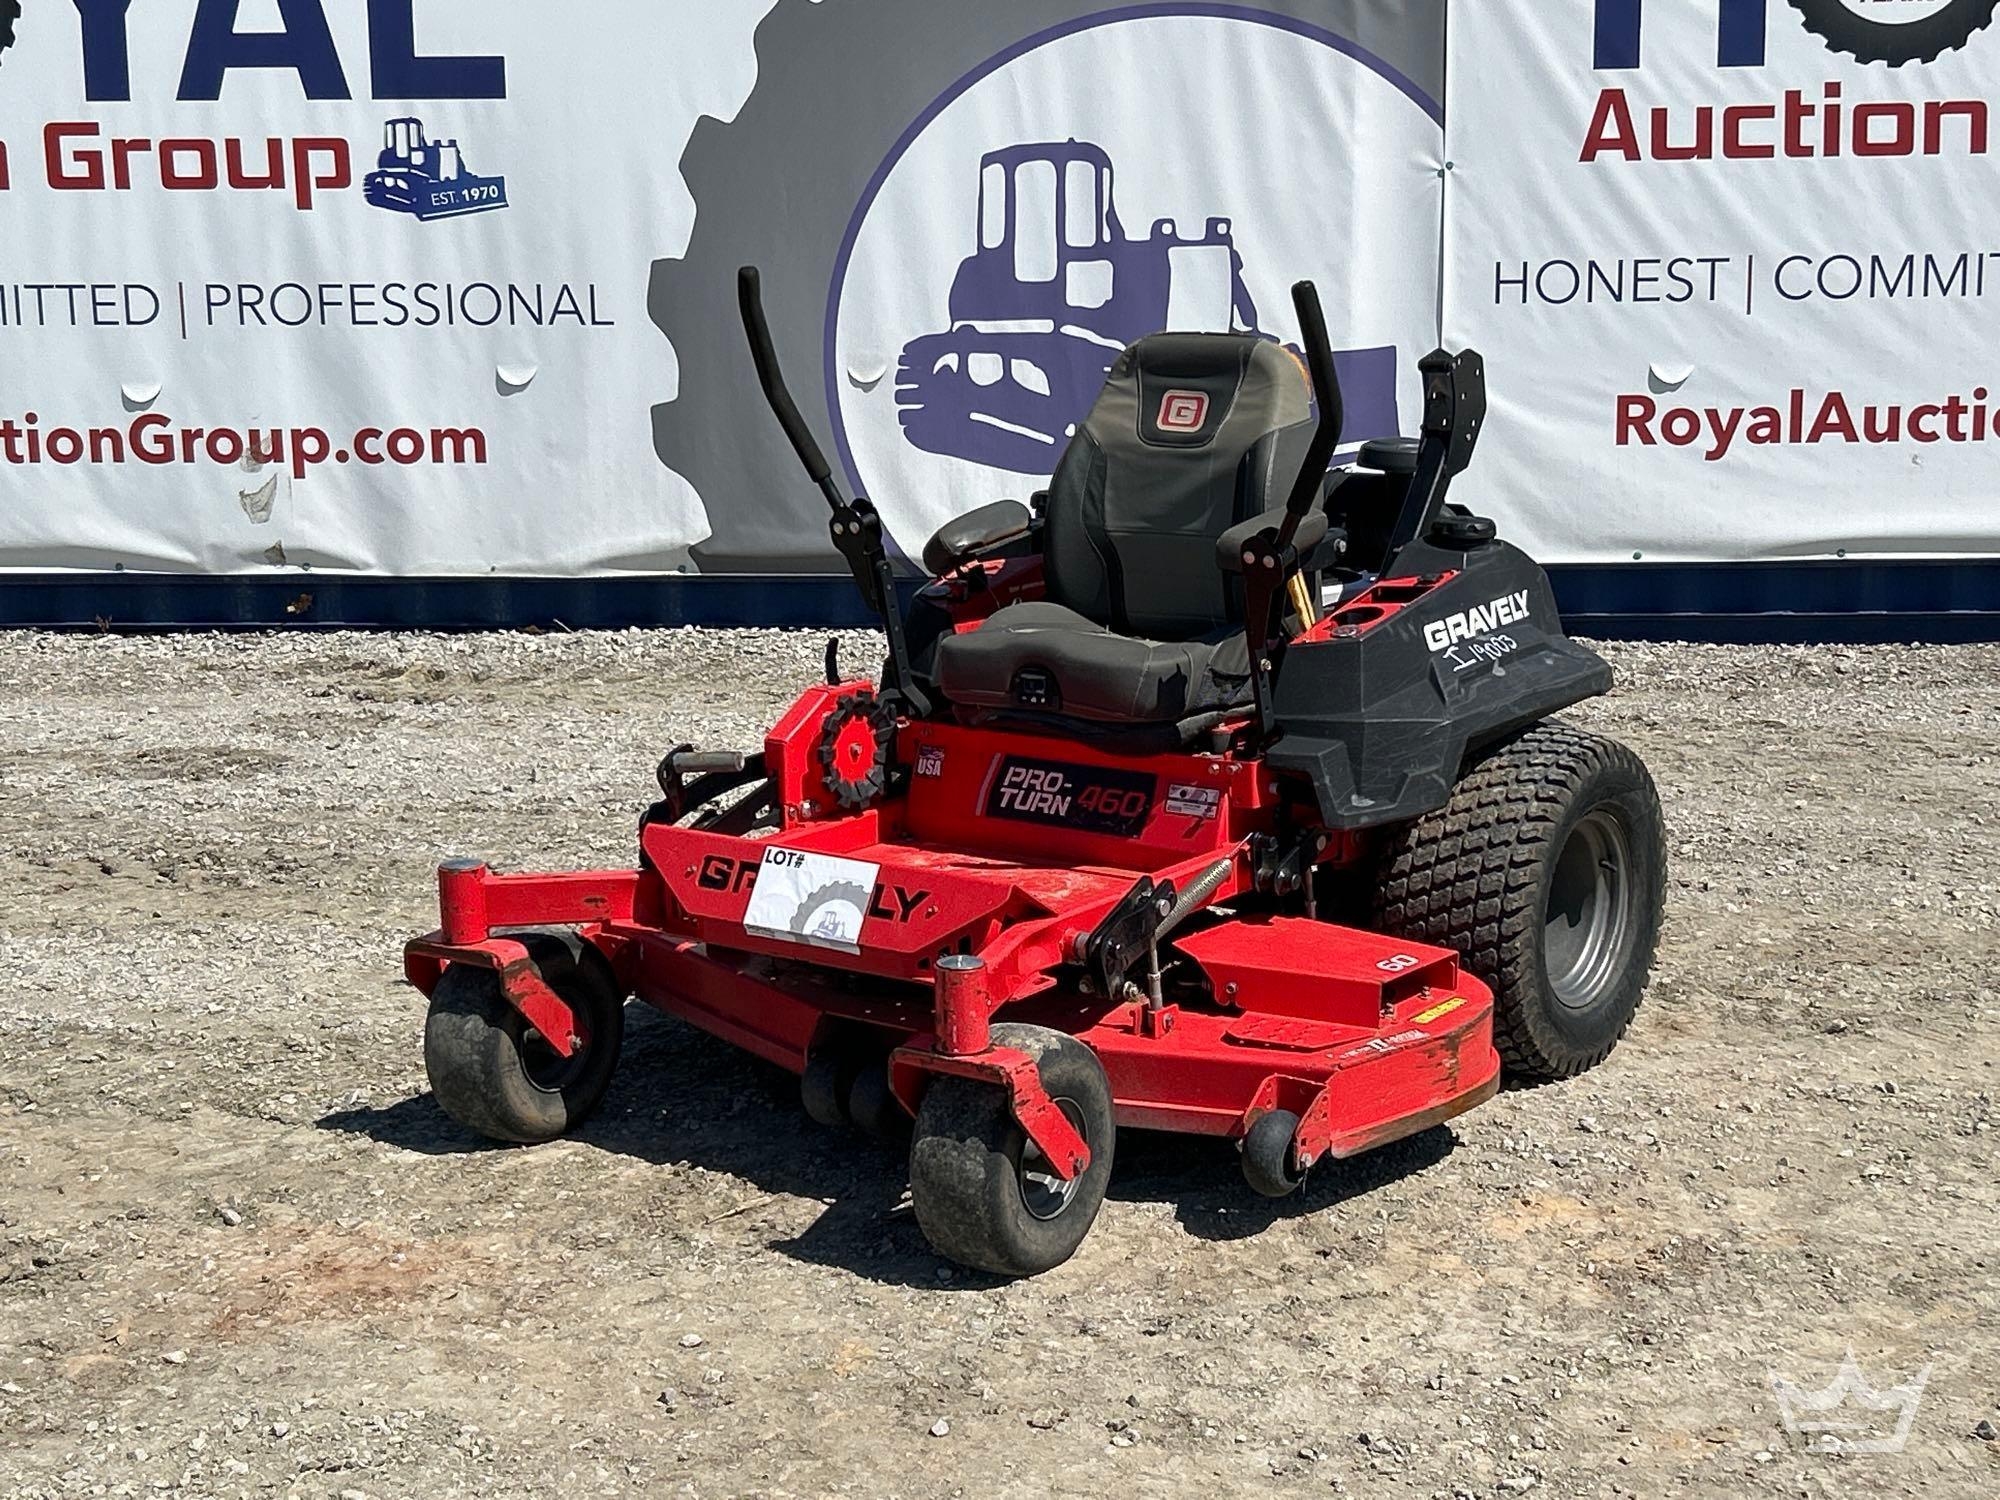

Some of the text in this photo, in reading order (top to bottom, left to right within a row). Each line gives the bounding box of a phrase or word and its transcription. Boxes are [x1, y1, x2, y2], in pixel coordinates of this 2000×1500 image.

[1579, 81, 1988, 162] Auction
[43, 121, 351, 210] Group
[431, 184, 499, 206] EST. 1970
[1494, 257, 1730, 304] HONEST
[0, 283, 160, 327] ITTED
[205, 283, 615, 326] PROFESSIONAL
[1615, 387, 2000, 461] RoyalAucti
[1423, 589, 1530, 652] GRAVELY
[917, 758, 941, 776] USA
[1000, 787, 1072, 817] TURN
[1003, 766, 1073, 793] PRO-
[1078, 784, 1147, 818] 460
[765, 849, 805, 868] LOT#
[1376, 954, 1419, 972] 60
